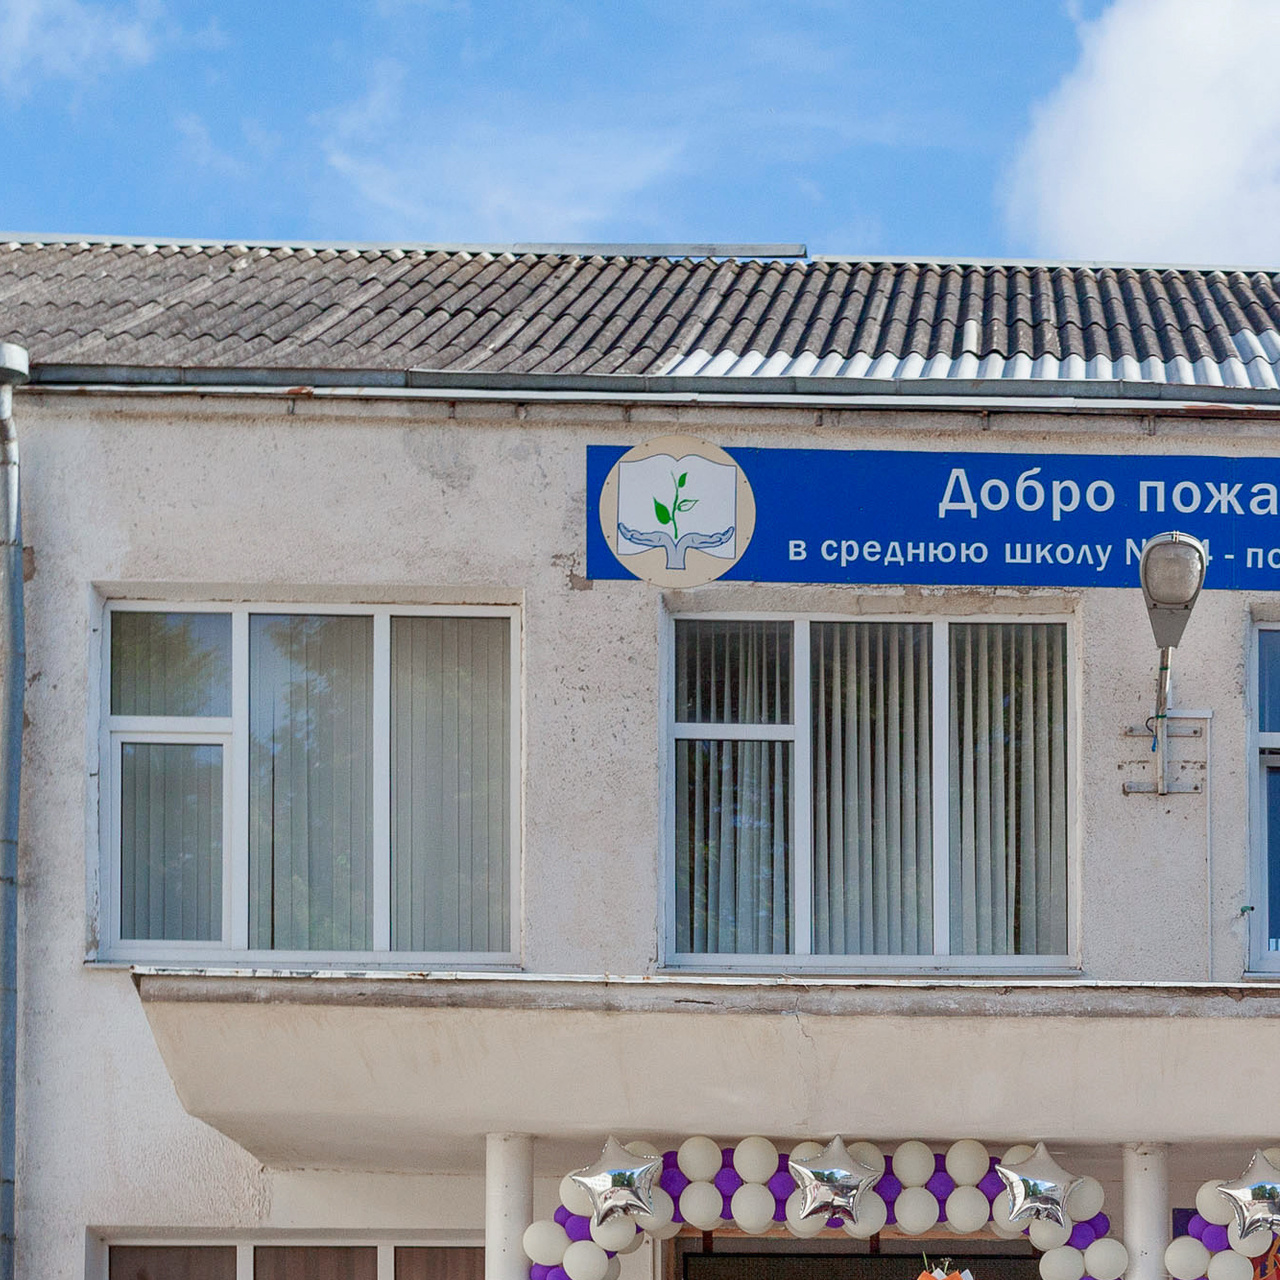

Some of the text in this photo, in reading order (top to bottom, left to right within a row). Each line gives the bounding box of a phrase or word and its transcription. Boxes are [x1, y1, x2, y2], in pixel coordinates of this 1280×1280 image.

[938, 468, 1115, 520] Добро
[789, 540, 807, 561] в
[820, 540, 988, 567] среднюю
[1005, 543, 1112, 572] школу
